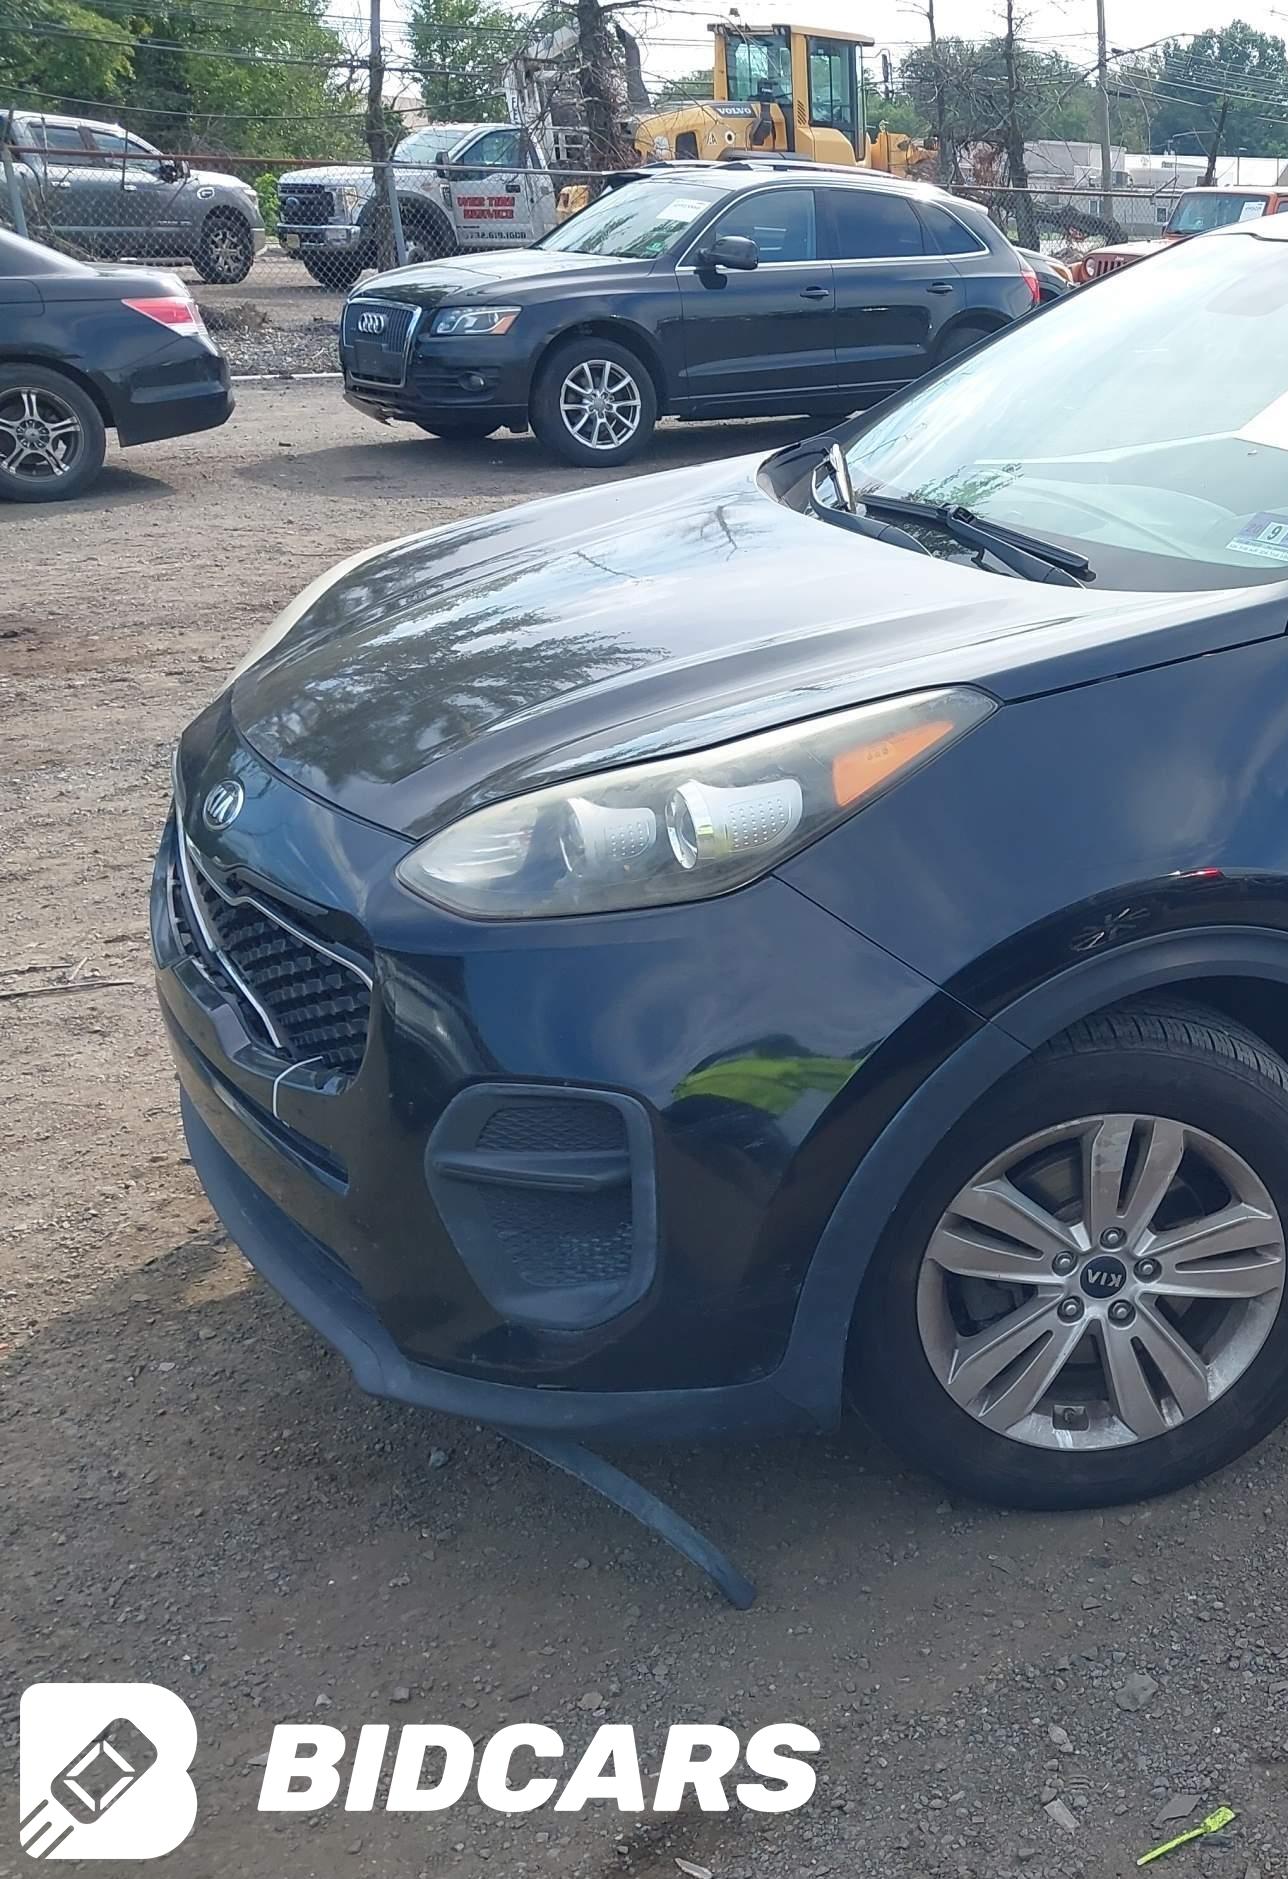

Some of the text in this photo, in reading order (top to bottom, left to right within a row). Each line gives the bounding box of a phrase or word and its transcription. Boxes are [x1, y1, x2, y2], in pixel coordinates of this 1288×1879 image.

[716, 107, 752, 115] VOLVO
[1267, 525, 1283, 541] 9
[1087, 1268, 1122, 1288] KIA
